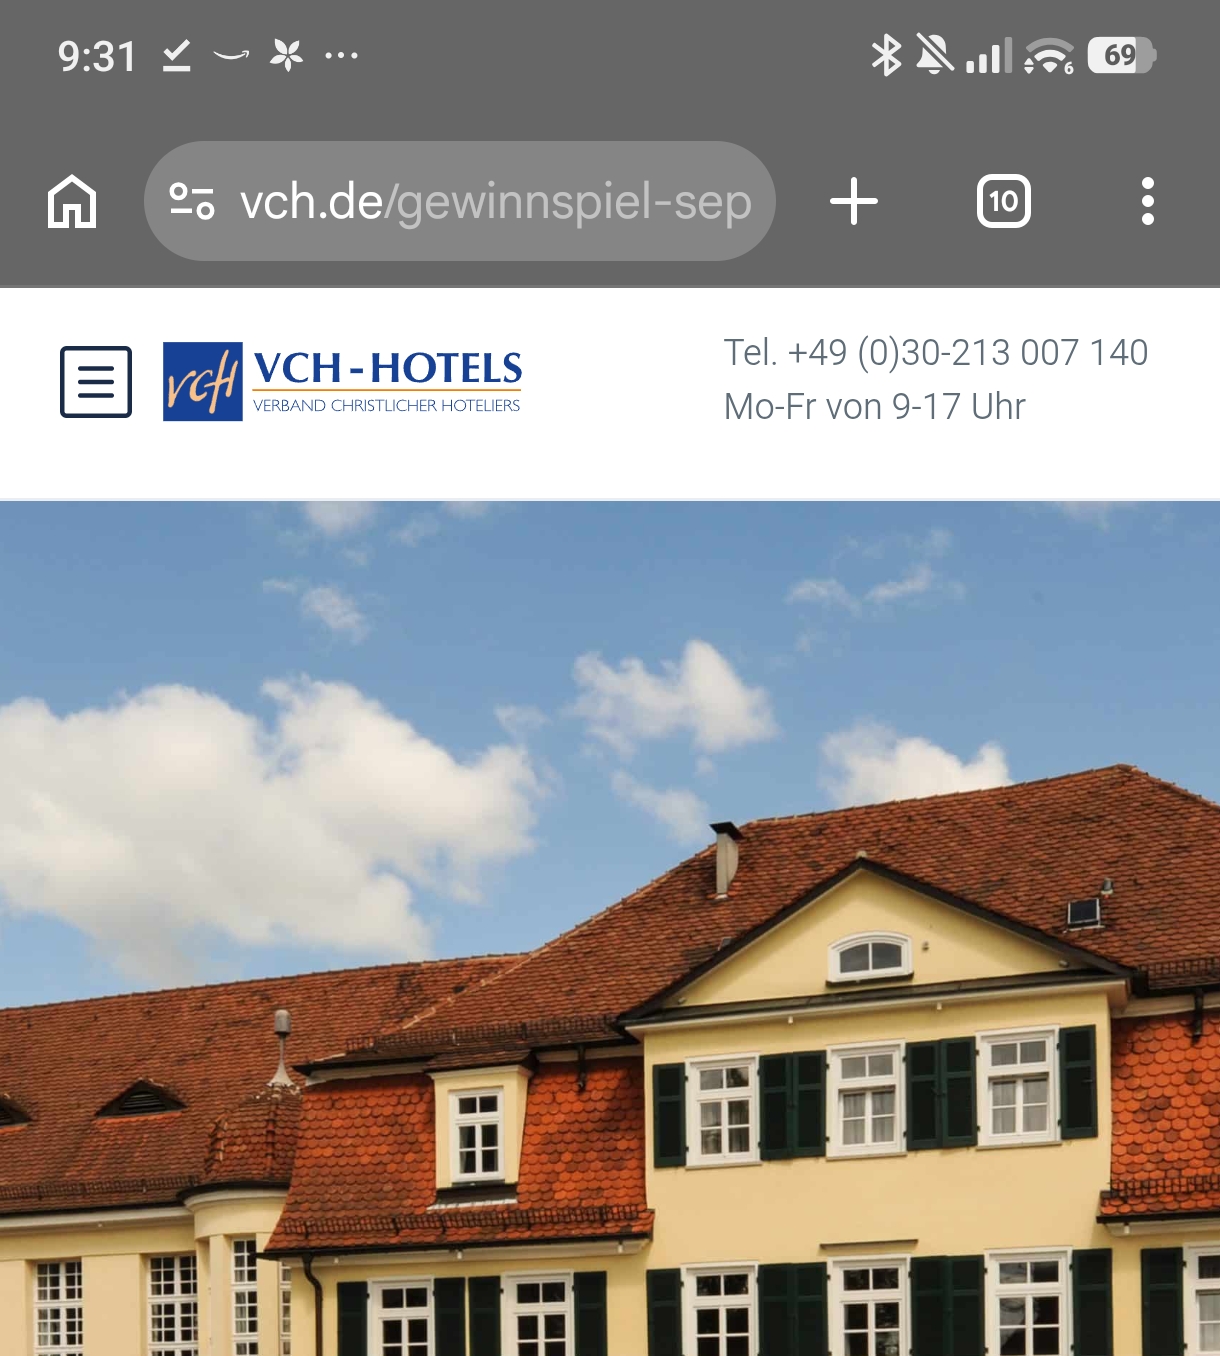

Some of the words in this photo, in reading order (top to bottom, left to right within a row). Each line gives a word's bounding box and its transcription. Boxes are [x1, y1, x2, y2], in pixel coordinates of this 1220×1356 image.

[58, 40, 133, 72] 9:31
[1104, 44, 1136, 65] 69
[240, 180, 752, 230] vch.de/gewinnspiel-sep
[989, 190, 1019, 212] 10
[724, 336, 777, 367] Tel.
[788, 338, 847, 367] +49
[858, 336, 1010, 374] (0)30-213
[1021, 338, 1079, 367] 007
[1092, 338, 1148, 367] 140
[252, 398, 327, 413] VERBAND
[330, 398, 438, 413] CHRISTLICHER
[441, 398, 521, 413] HOTELIERS
[725, 391, 817, 420] Mo-Fr
[826, 398, 881, 420] von
[892, 392, 961, 420] 9-17
[972, 391, 1027, 420] Uhr
